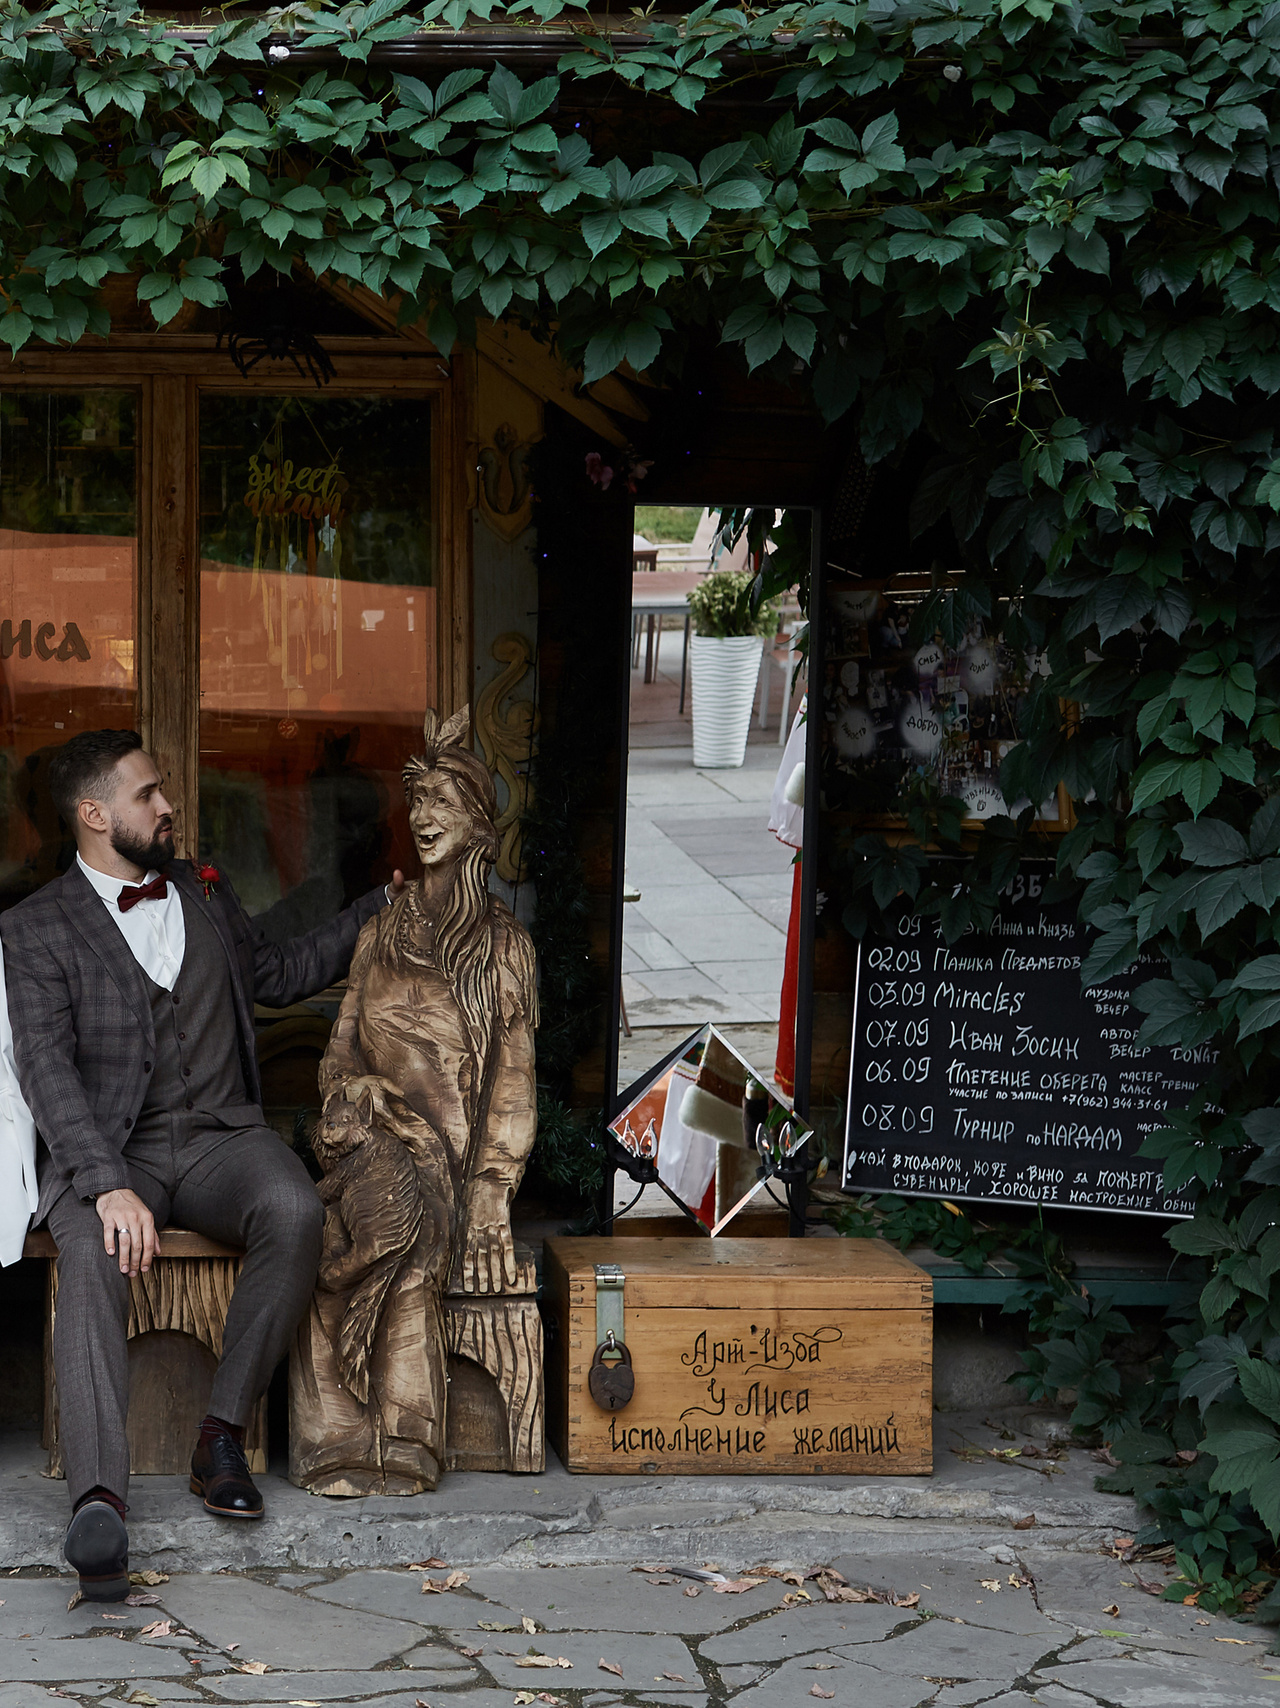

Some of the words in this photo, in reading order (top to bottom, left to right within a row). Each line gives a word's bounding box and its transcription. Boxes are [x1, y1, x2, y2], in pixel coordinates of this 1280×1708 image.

[918, 650, 940, 666] СМЕХ
[906, 715, 939, 736] ДОБРО
[868, 946, 922, 974] 02.09
[868, 981, 926, 1009] 03.09
[865, 1017, 930, 1049] 07.09
[865, 1056, 932, 1083] 06.09
[1039, 1071, 1109, 1093] ОБЕРЕГА
[1119, 1071, 1164, 1083] МАСТЕР
[948, 1087, 989, 1100] УЧАСТИЕ
[1120, 1083, 1153, 1096] КЛАСС
[862, 1103, 934, 1134] 08.09
[1042, 1121, 1123, 1152] НАРДАМ
[972, 1159, 1007, 1179] КОФЕ
[1026, 1164, 1065, 1184] ВИНО
[988, 1180, 1059, 1201] ХОРОШЕЕ
